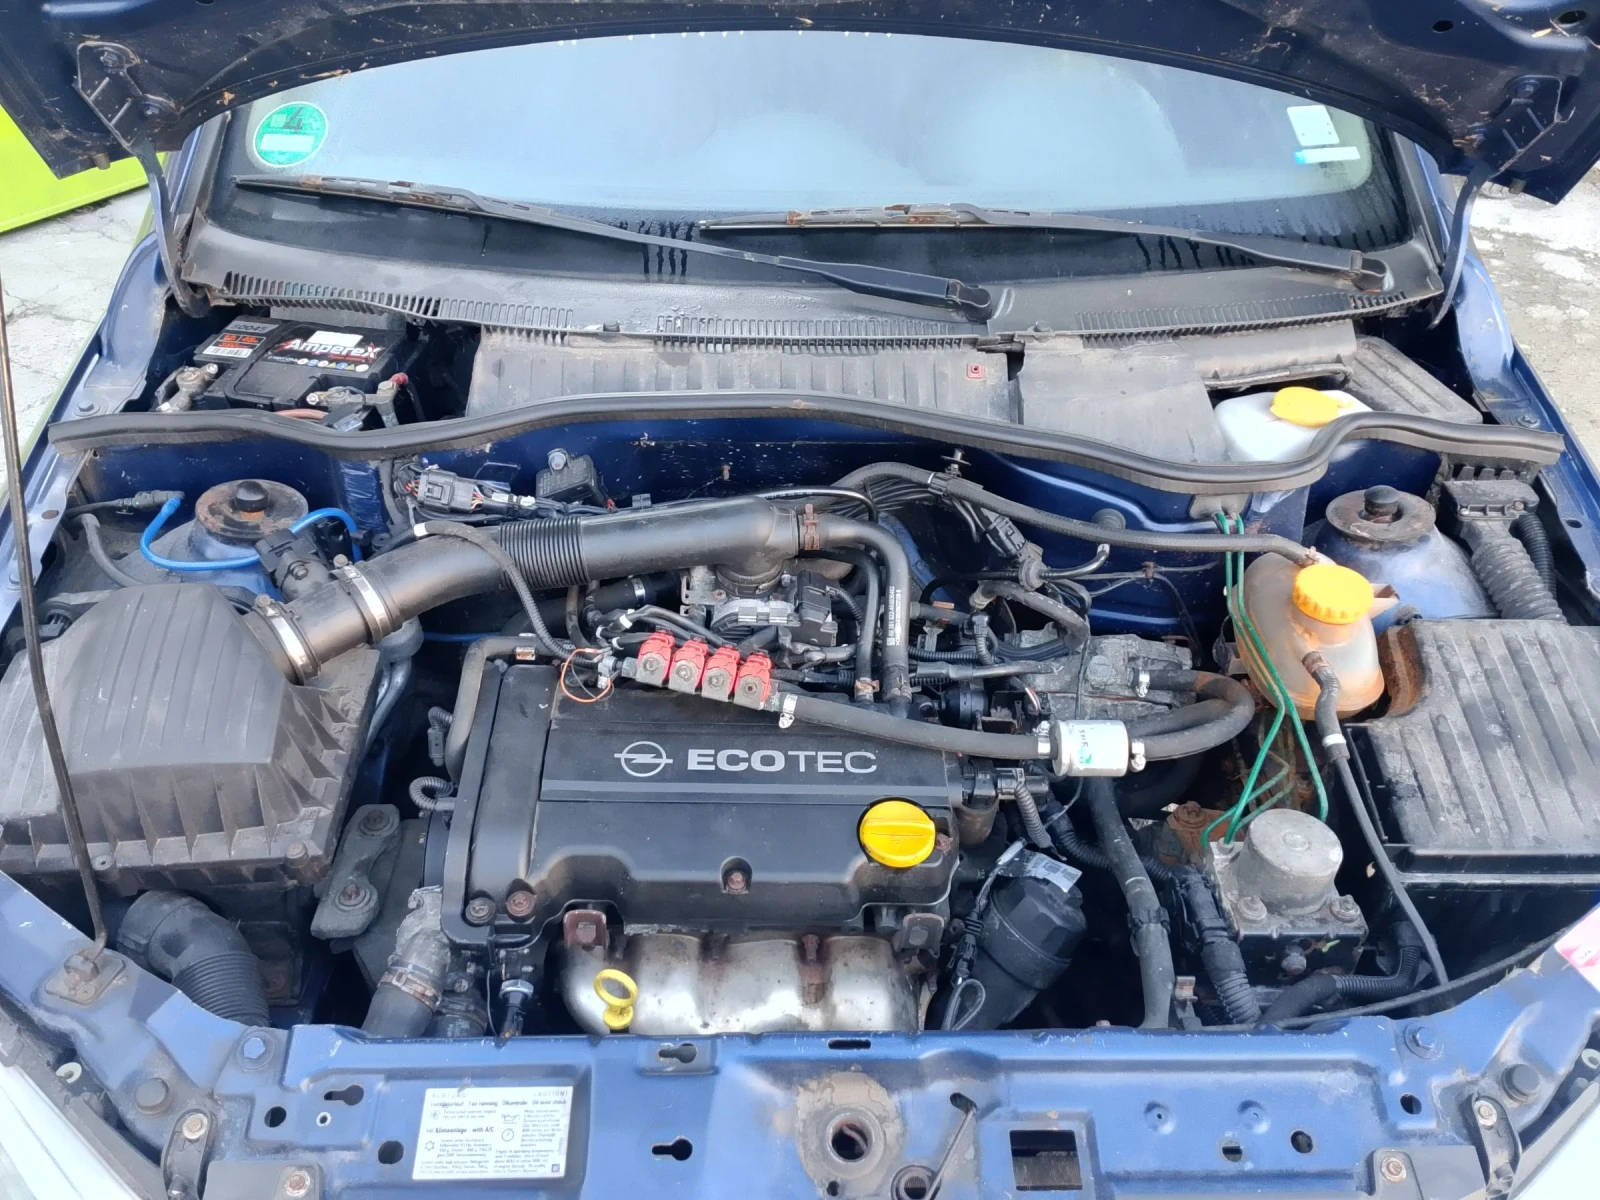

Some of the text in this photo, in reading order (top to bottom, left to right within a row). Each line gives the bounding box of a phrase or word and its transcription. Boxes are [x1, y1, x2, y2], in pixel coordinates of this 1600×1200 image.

[283, 106, 304, 134] 4
[284, 337, 382, 359] AmpereX
[687, 749, 878, 774] ECOTEC
